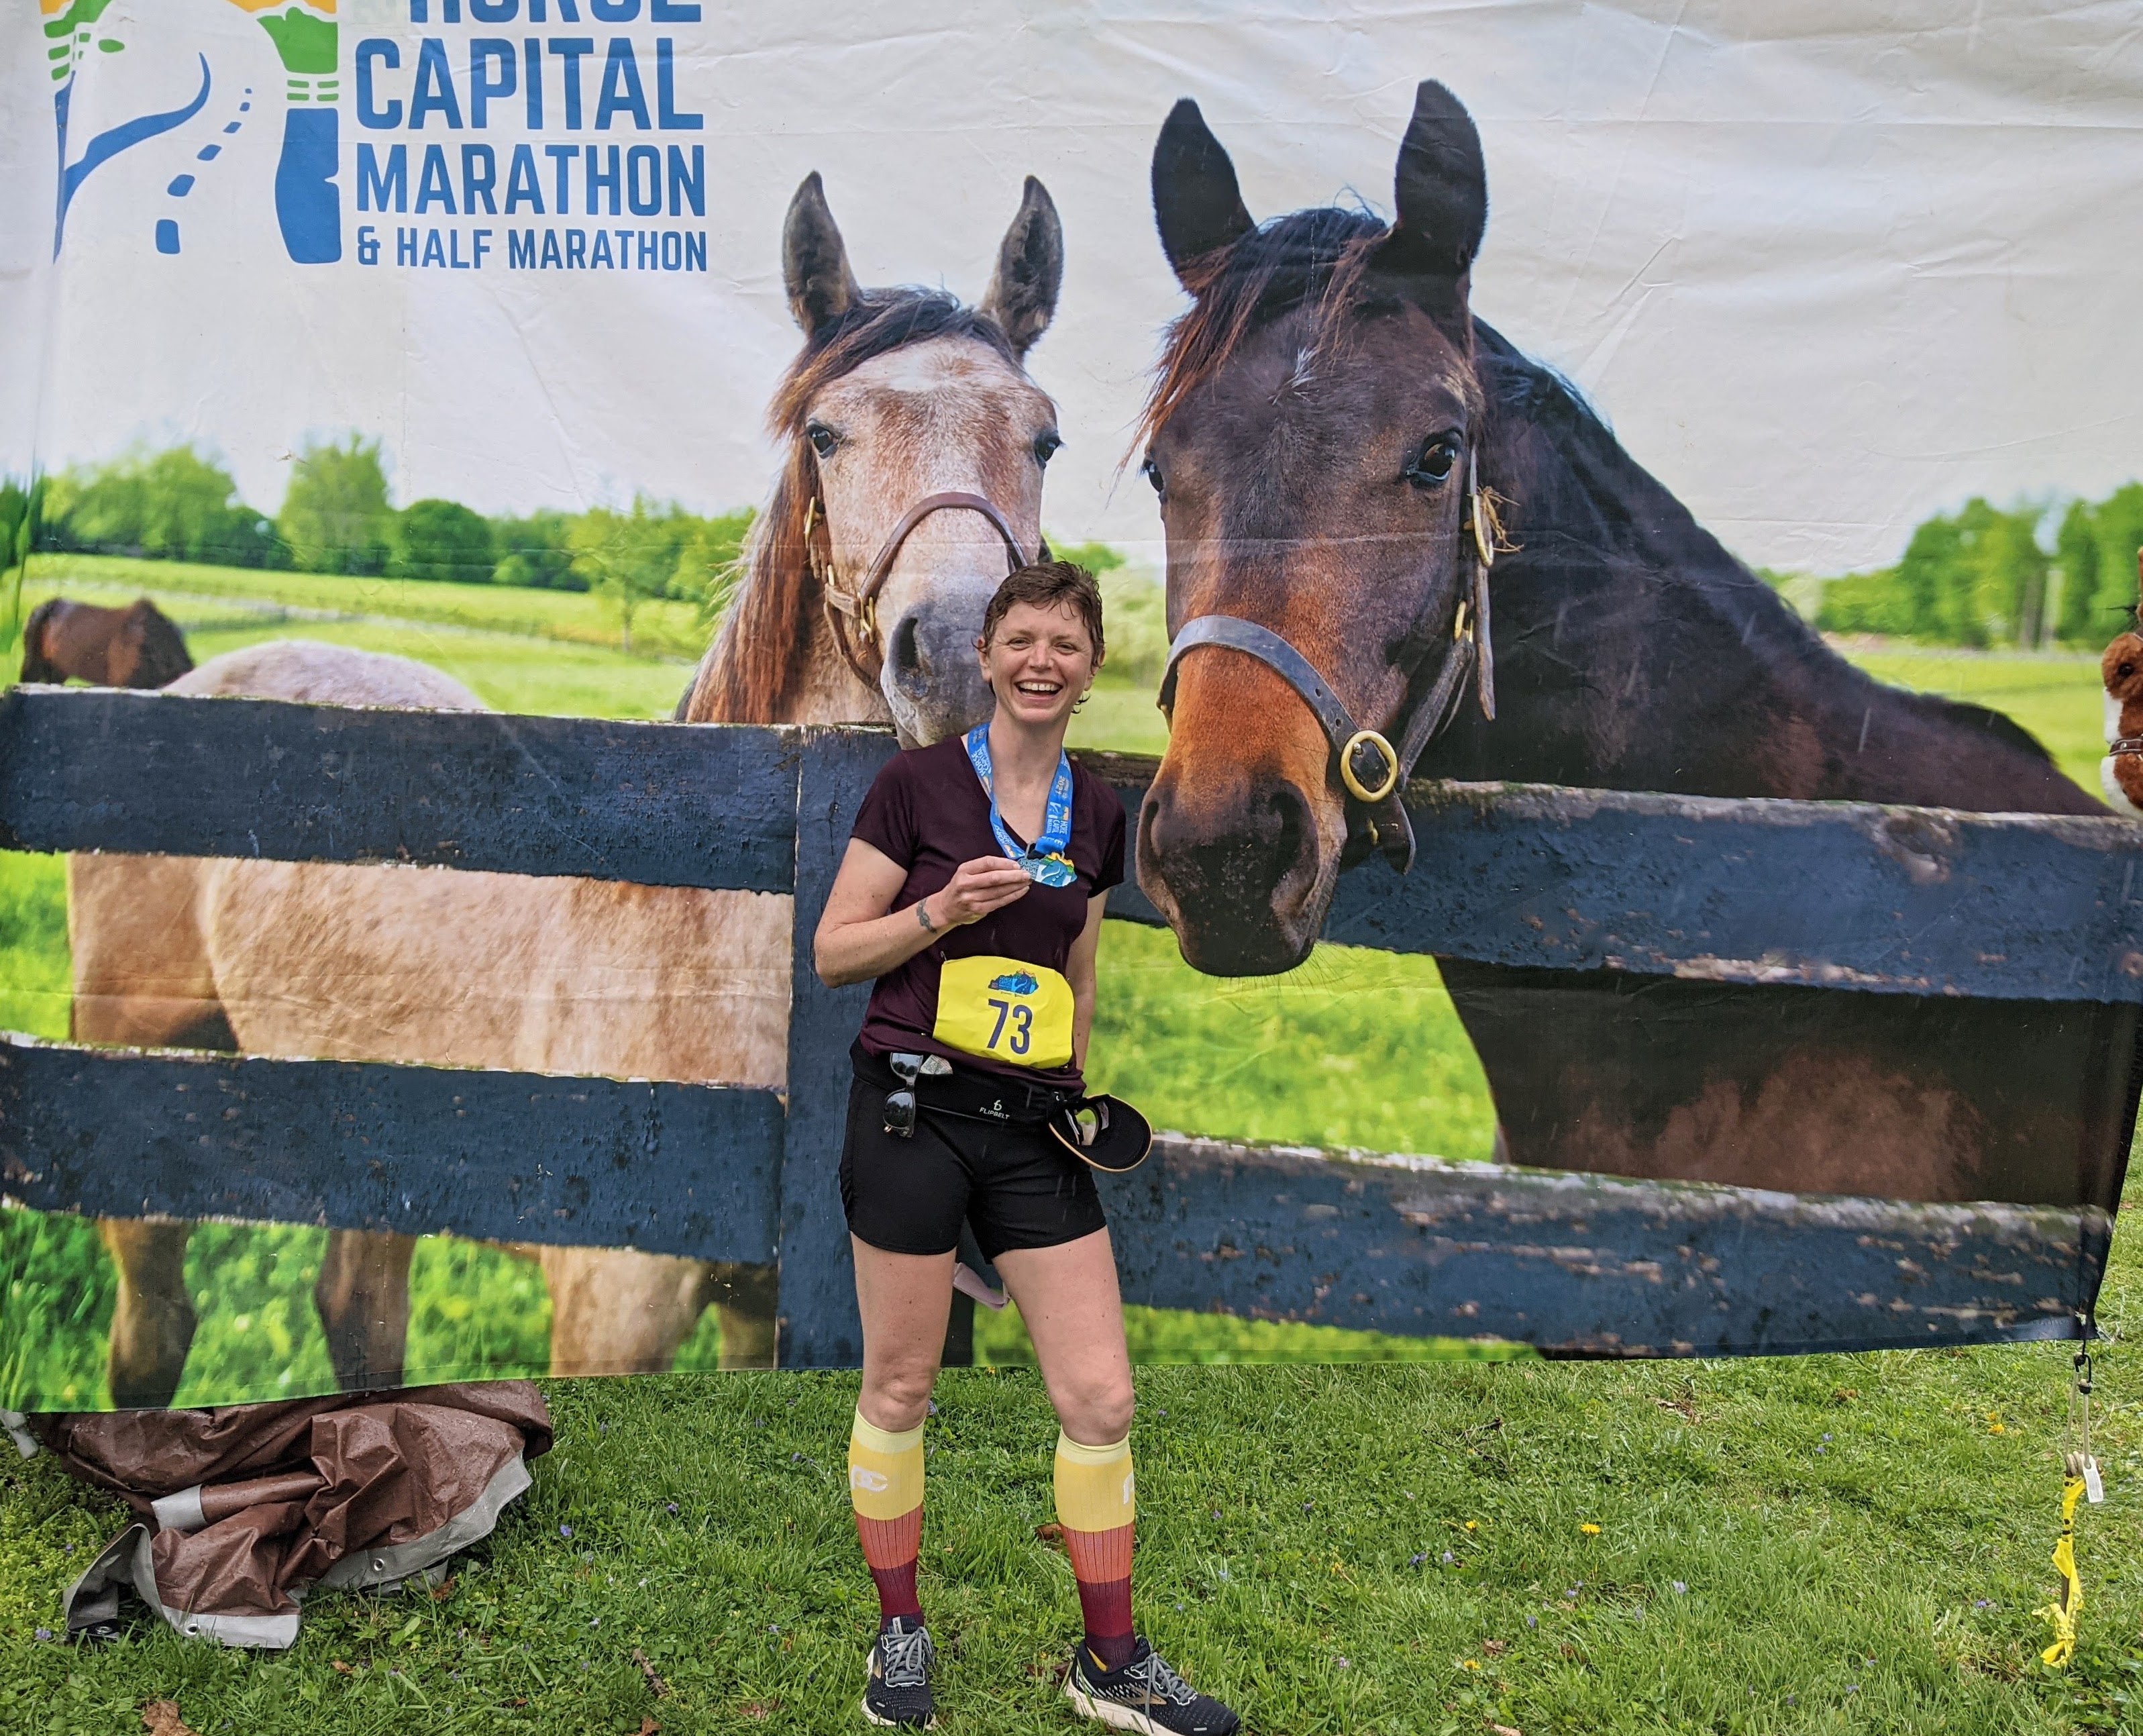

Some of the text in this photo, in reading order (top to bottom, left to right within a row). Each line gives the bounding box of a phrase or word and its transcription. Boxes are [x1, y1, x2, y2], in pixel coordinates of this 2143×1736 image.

[356, 38, 703, 130] CAPITAL
[357, 143, 705, 216] MARATHON
[358, 225, 707, 272] & HALF MARATHON
[987, 998, 1033, 1055] 73
[979, 1107, 1010, 1120] FLIPBELT
